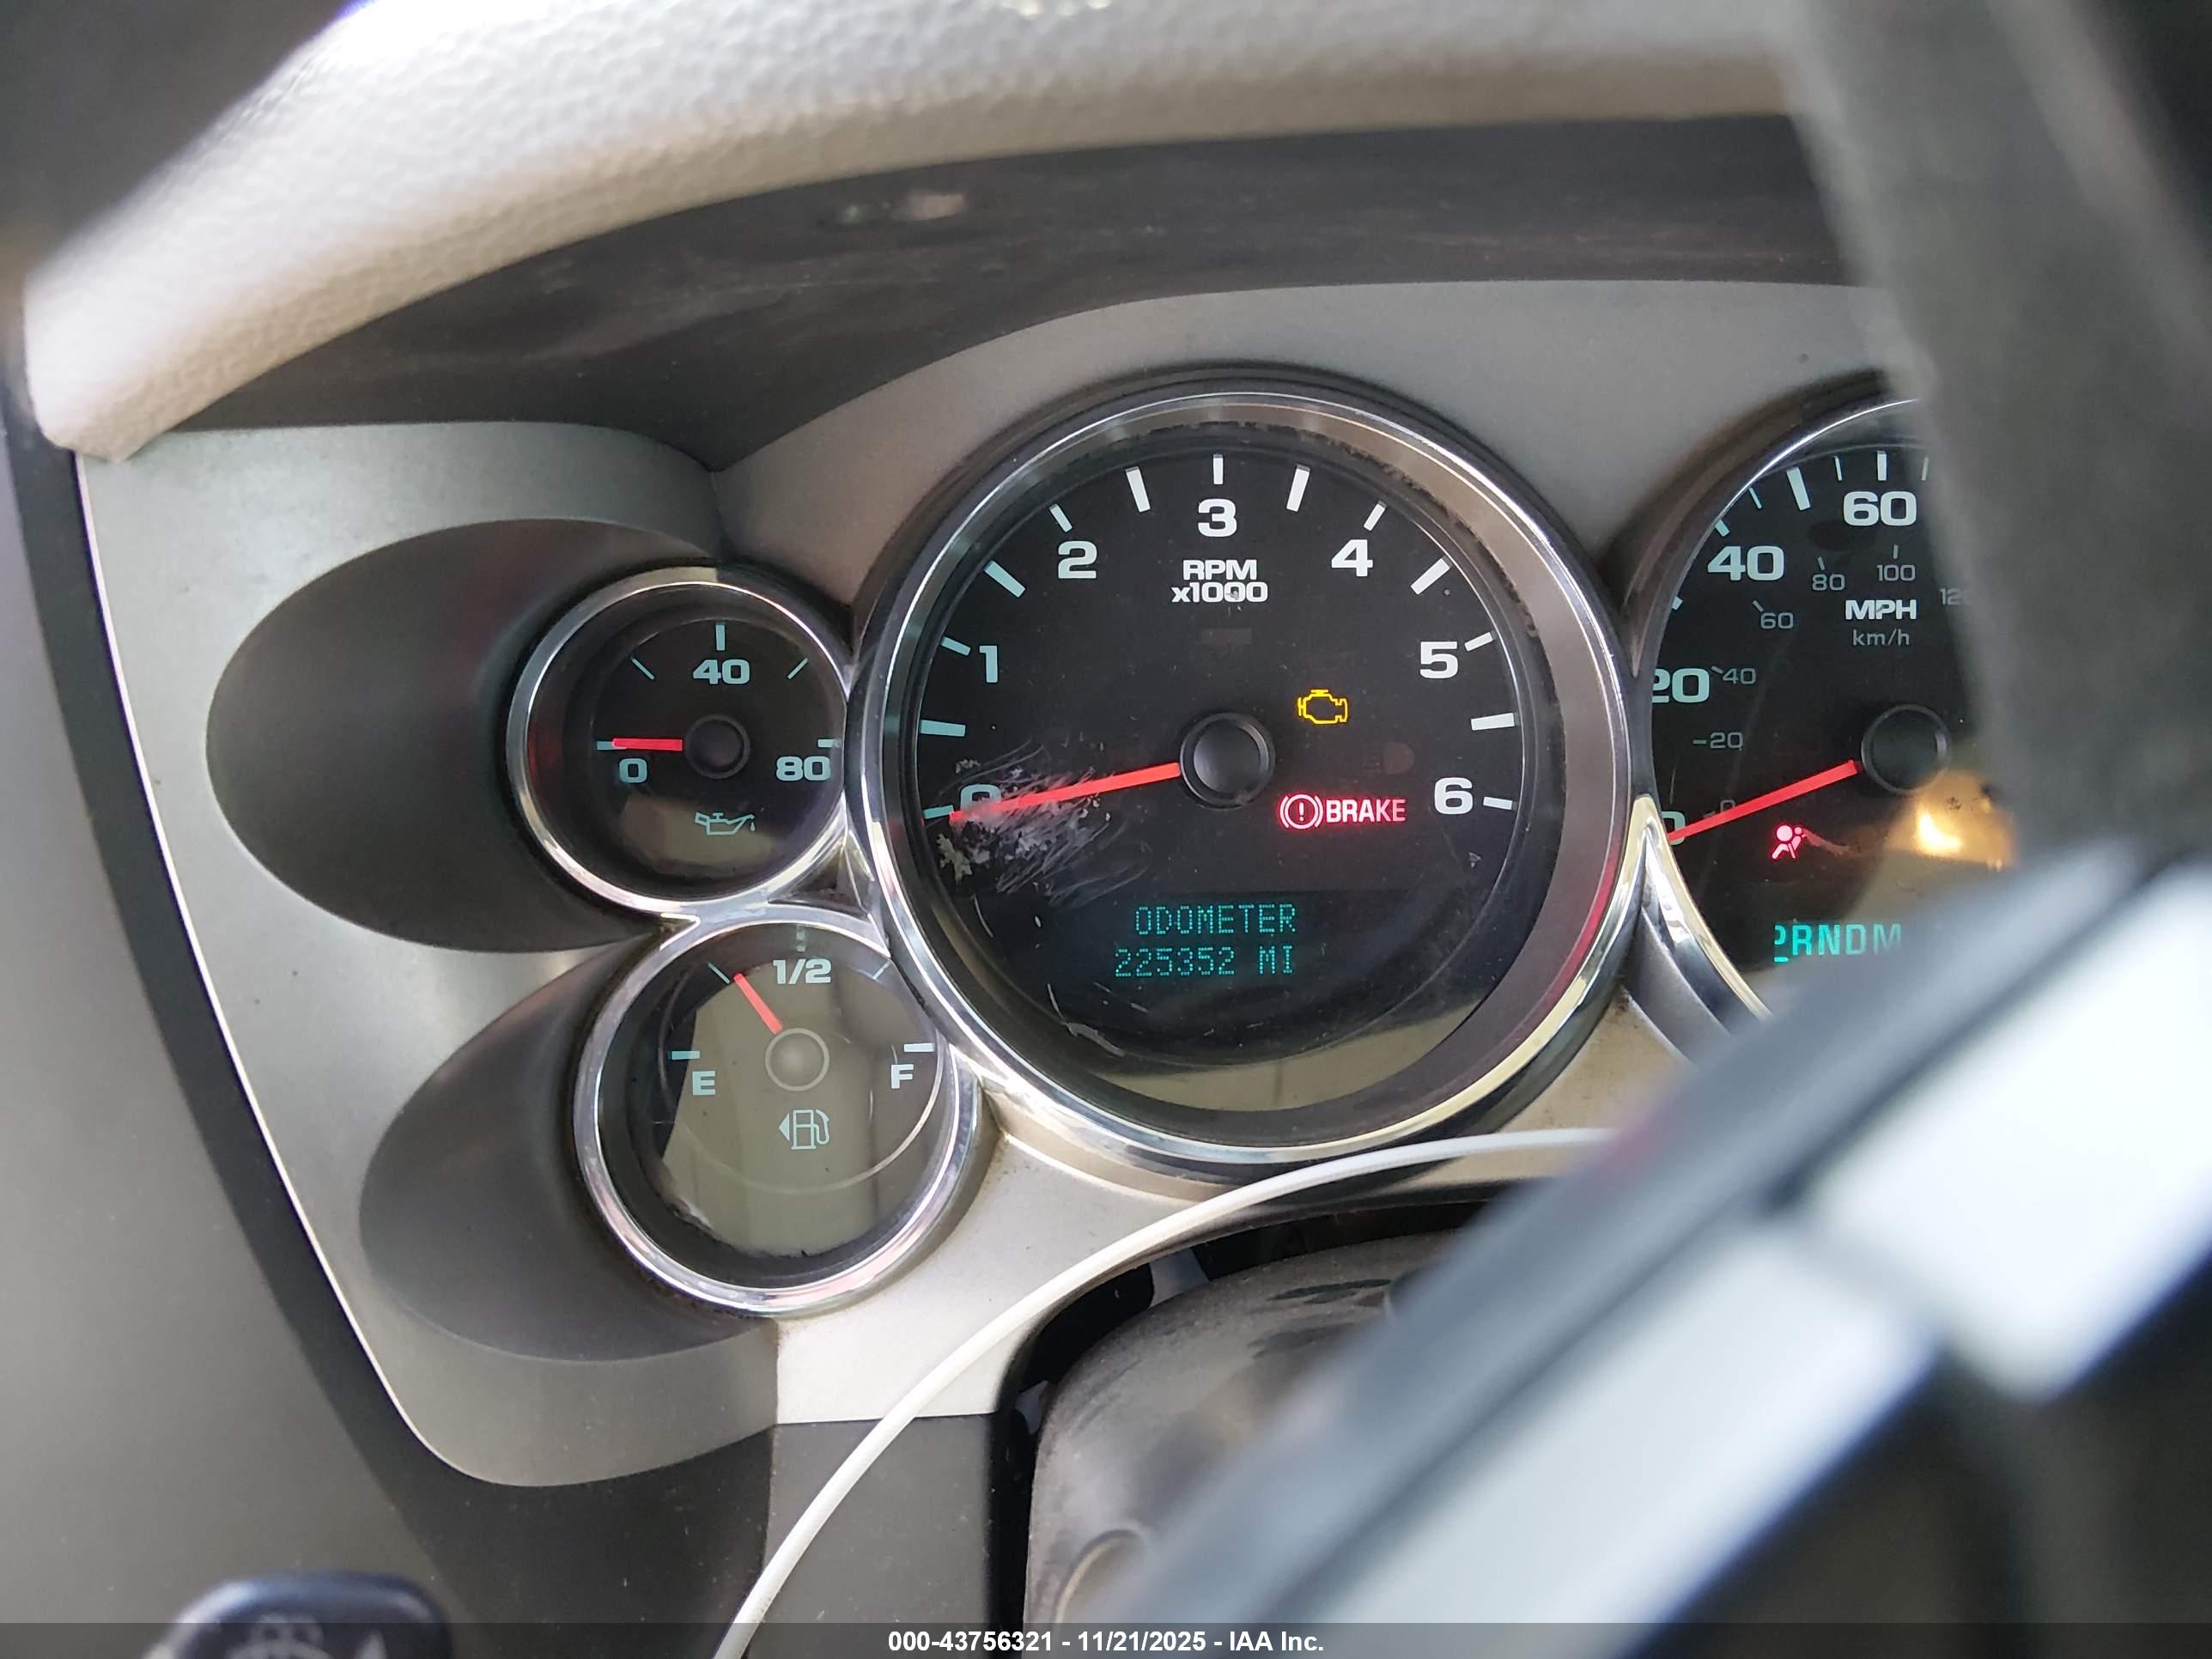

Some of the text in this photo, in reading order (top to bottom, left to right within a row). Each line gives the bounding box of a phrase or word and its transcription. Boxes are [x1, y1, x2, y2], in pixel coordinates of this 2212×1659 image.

[1197, 499, 1237, 537] 3
[1843, 490, 1917, 526] 60
[1057, 541, 1097, 579] 2
[1182, 560, 1257, 580] RPM
[1332, 539, 1373, 576] 4
[1707, 546, 1784, 581] 40
[1811, 573, 1845, 591] 80
[1876, 563, 1916, 582] 100
[1759, 611, 1794, 630] 60
[1845, 599, 1917, 620] MPH
[1852, 629, 1910, 647] km/h
[692, 659, 750, 684] 40
[979, 646, 999, 683] 1
[1419, 641, 1459, 678] 5
[1651, 668, 1710, 703] 20
[1722, 667, 1756, 684] 40
[617, 759, 647, 783] 0
[775, 757, 831, 781] 80
[1434, 777, 1474, 815] 6
[1325, 799, 1407, 823] BRAKE
[1134, 905, 1297, 935] ODOMETER
[773, 959, 831, 984] 1/2
[1115, 946, 1295, 977] 225352 MI
[692, 1070, 716, 1096] E
[890, 1063, 914, 1089] F
